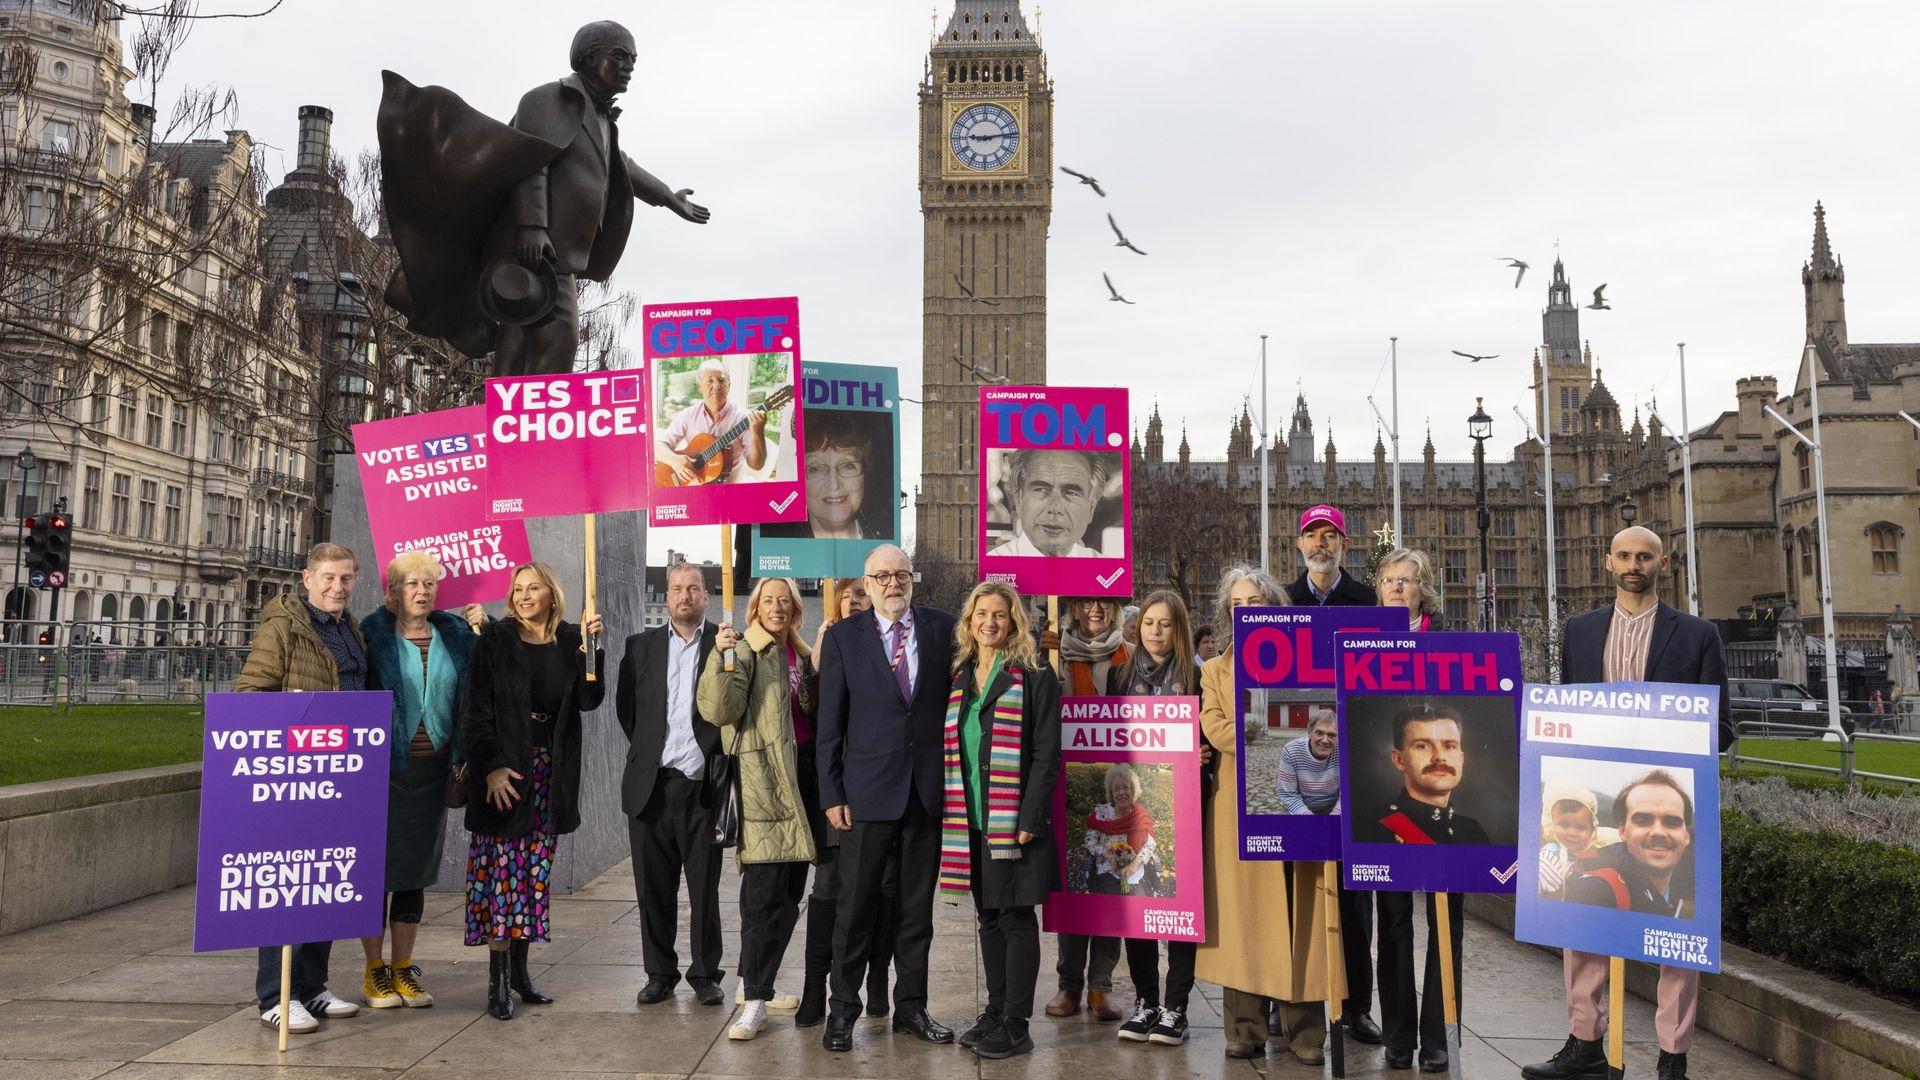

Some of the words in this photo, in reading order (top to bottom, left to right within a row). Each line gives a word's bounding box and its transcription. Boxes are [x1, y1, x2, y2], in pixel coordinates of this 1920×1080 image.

[650, 309, 693, 318] CAMPAIGN
[651, 316, 793, 354] GEOFF.
[493, 380, 570, 411] YES
[802, 378, 893, 408] DITH.
[492, 406, 647, 443] CHOICE.
[986, 402, 1123, 447] TOM.
[362, 444, 419, 467] VOTE
[425, 437, 468, 456] YES
[473, 433, 486, 448] T
[385, 454, 487, 484] ASSISTED
[405, 477, 478, 502] DYING.
[656, 507, 687, 515] DIGNITY
[394, 531, 469, 553] CAMPAIGN
[473, 525, 501, 538] FOR
[396, 535, 502, 562] GNITY
[1242, 627, 1380, 684] OL
[1343, 640, 1394, 648] CAMPAIGN
[1396, 640, 1416, 648] FOR
[1343, 652, 1514, 691] KEITH.
[1061, 703, 1146, 719] AMPAIGN
[1153, 703, 1192, 719] FOR
[1529, 688, 1650, 711] CAMPAIGN
[1660, 694, 1710, 715] FOR
[211, 730, 282, 750] VOTE
[292, 728, 343, 748] YES
[353, 728, 385, 746] TO
[1072, 728, 1166, 748] ALISON
[1534, 716, 1572, 739] Ian
[232, 754, 364, 776] ASSISTED
[252, 780, 342, 802] DYING.
[222, 849, 315, 866] CAMPAIGN
[323, 847, 357, 860] FOR
[220, 860, 356, 889] DIGNITY
[219, 889, 252, 912] IN
[258, 882, 363, 909] DYING.
[1144, 915, 1194, 926] DIGNITY
[1144, 924, 1157, 933] IN
[1158, 925, 1199, 936] DYING.
[1644, 928, 1688, 940] CAMPAIGN
[1691, 935, 1708, 943] FOR
[1644, 934, 1708, 953] DIGNITY
[1644, 945, 1658, 957] IN
[1661, 948, 1712, 966] DYING.
